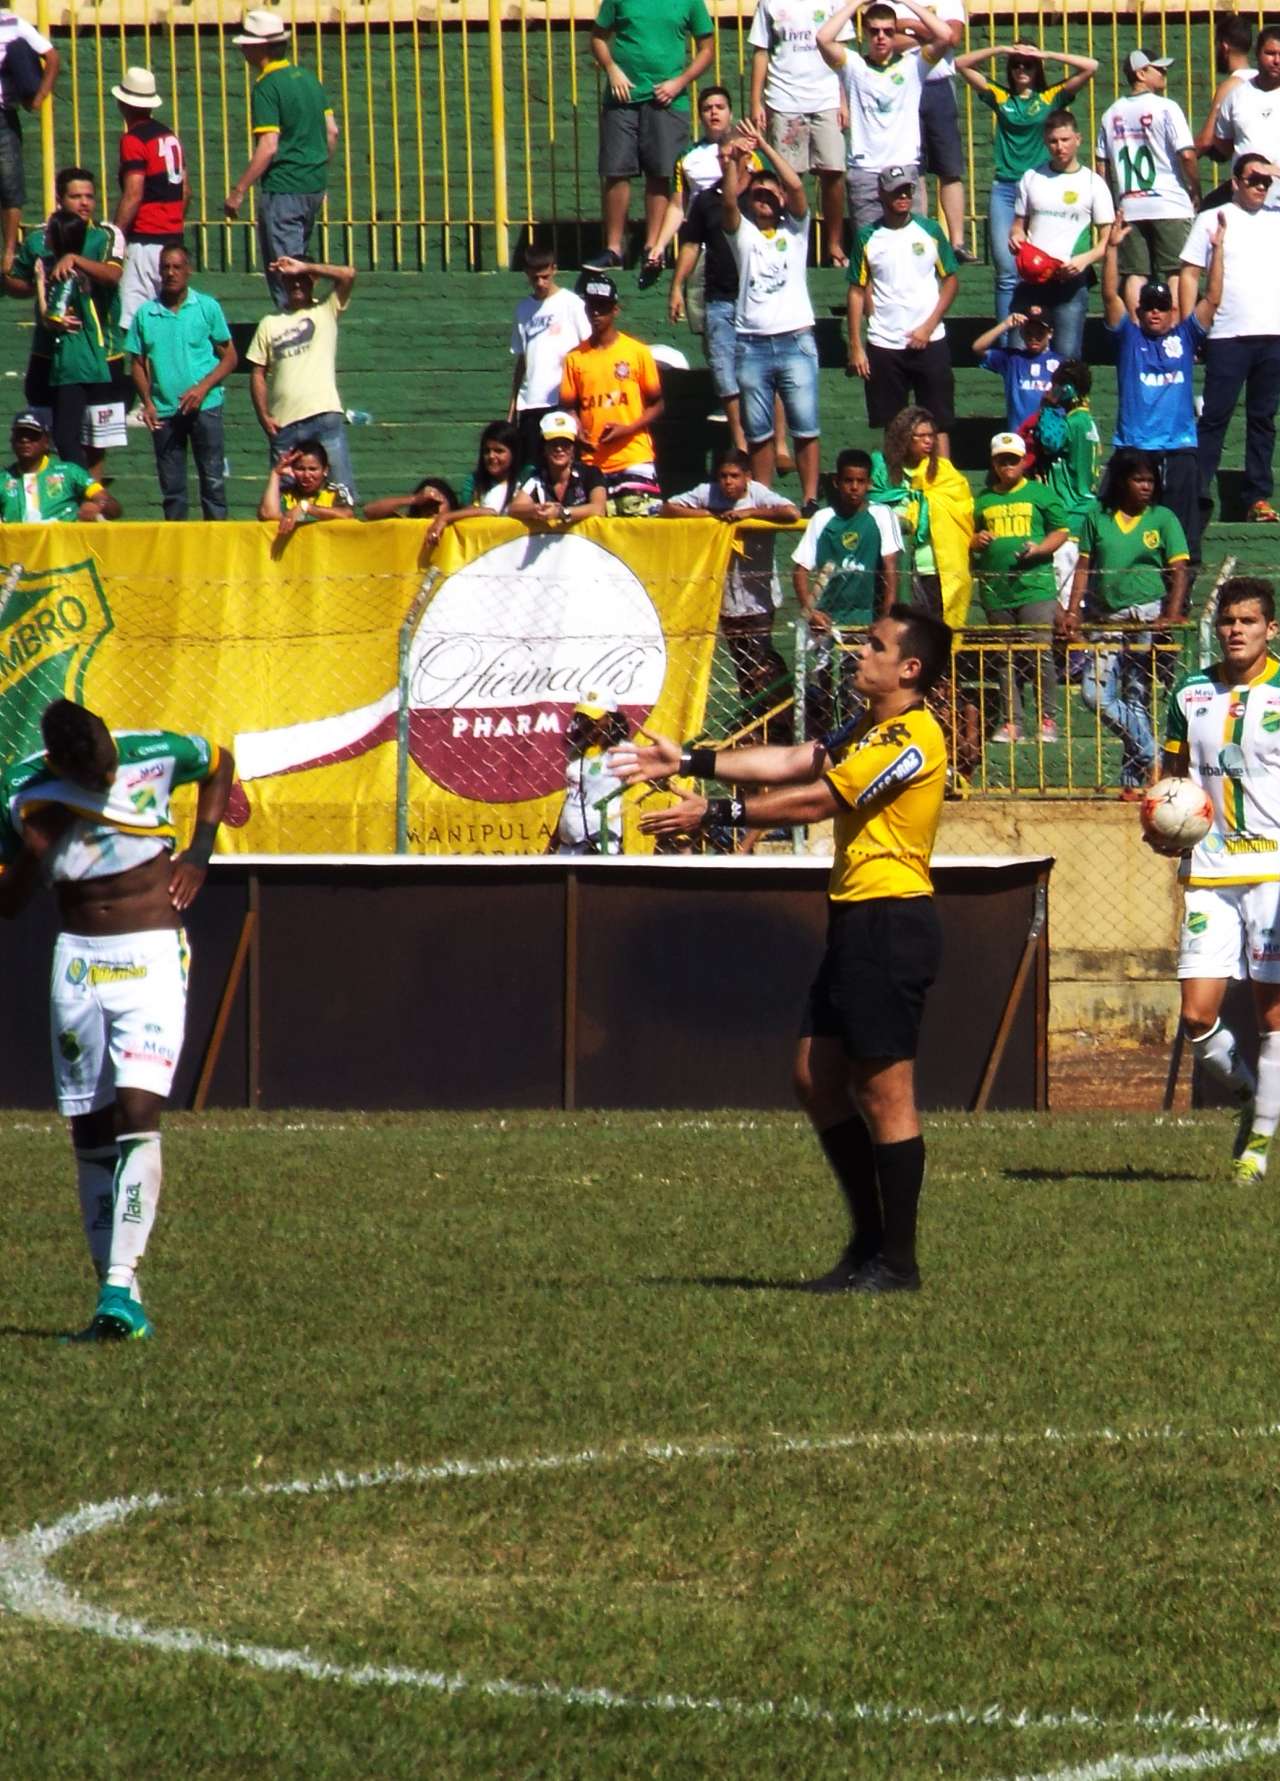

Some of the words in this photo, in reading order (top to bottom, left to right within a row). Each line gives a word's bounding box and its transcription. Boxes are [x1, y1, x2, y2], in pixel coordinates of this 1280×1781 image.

[157, 135, 184, 184] 10
[1119, 145, 1156, 191] 10
[580, 391, 629, 410] CAIXA
